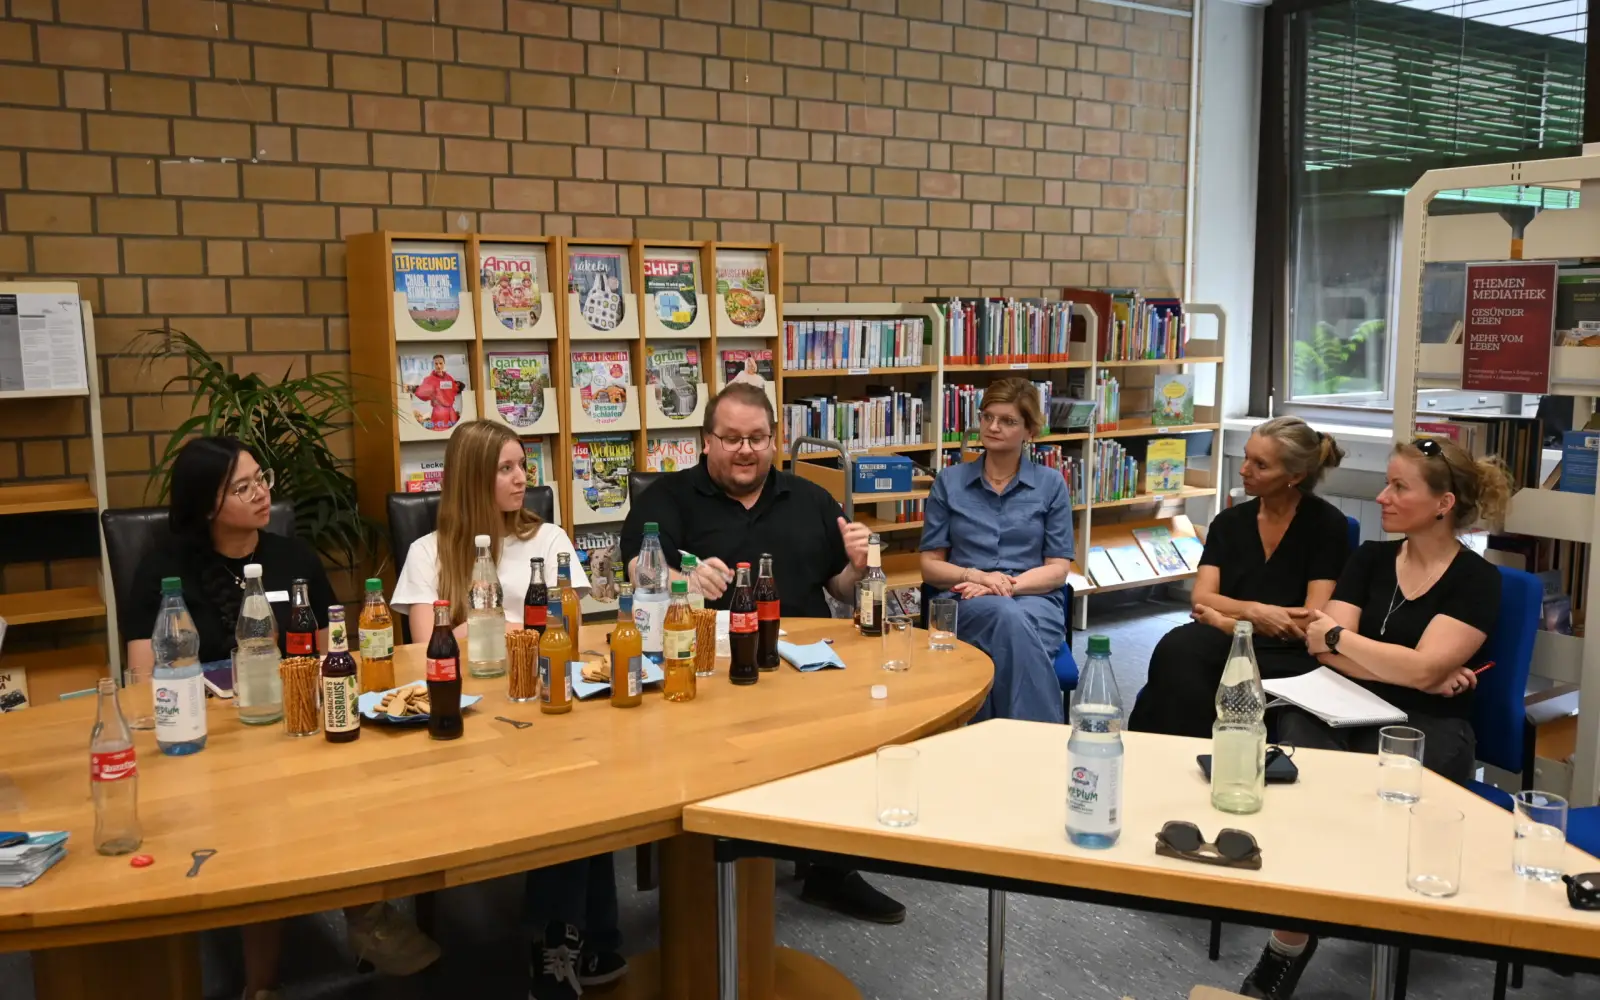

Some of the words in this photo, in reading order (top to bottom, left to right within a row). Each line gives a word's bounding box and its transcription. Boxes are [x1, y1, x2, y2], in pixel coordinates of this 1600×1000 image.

[484, 256, 531, 272] Anna
[644, 262, 679, 276] CHIP
[1473, 278, 1526, 289] THEMEN
[1472, 289, 1547, 300] MEDIATHEK
[1471, 307, 1525, 317] GESÜNDER
[1471, 317, 1502, 325] LEBEN
[1469, 334, 1498, 343] MEHR
[1500, 334, 1524, 343] VOM
[1469, 343, 1500, 351] LEBEN
[573, 353, 596, 361] Good
[598, 352, 626, 361] Health
[654, 350, 685, 364] grün
[495, 357, 537, 370] garten
[573, 446, 589, 455] Lisa
[589, 441, 631, 457] Wohnen
[647, 441, 694, 457] LIVING
[421, 461, 444, 469] Lecke
[576, 533, 614, 549] Hund
[333, 681, 346, 728] FASSBRAUSE
